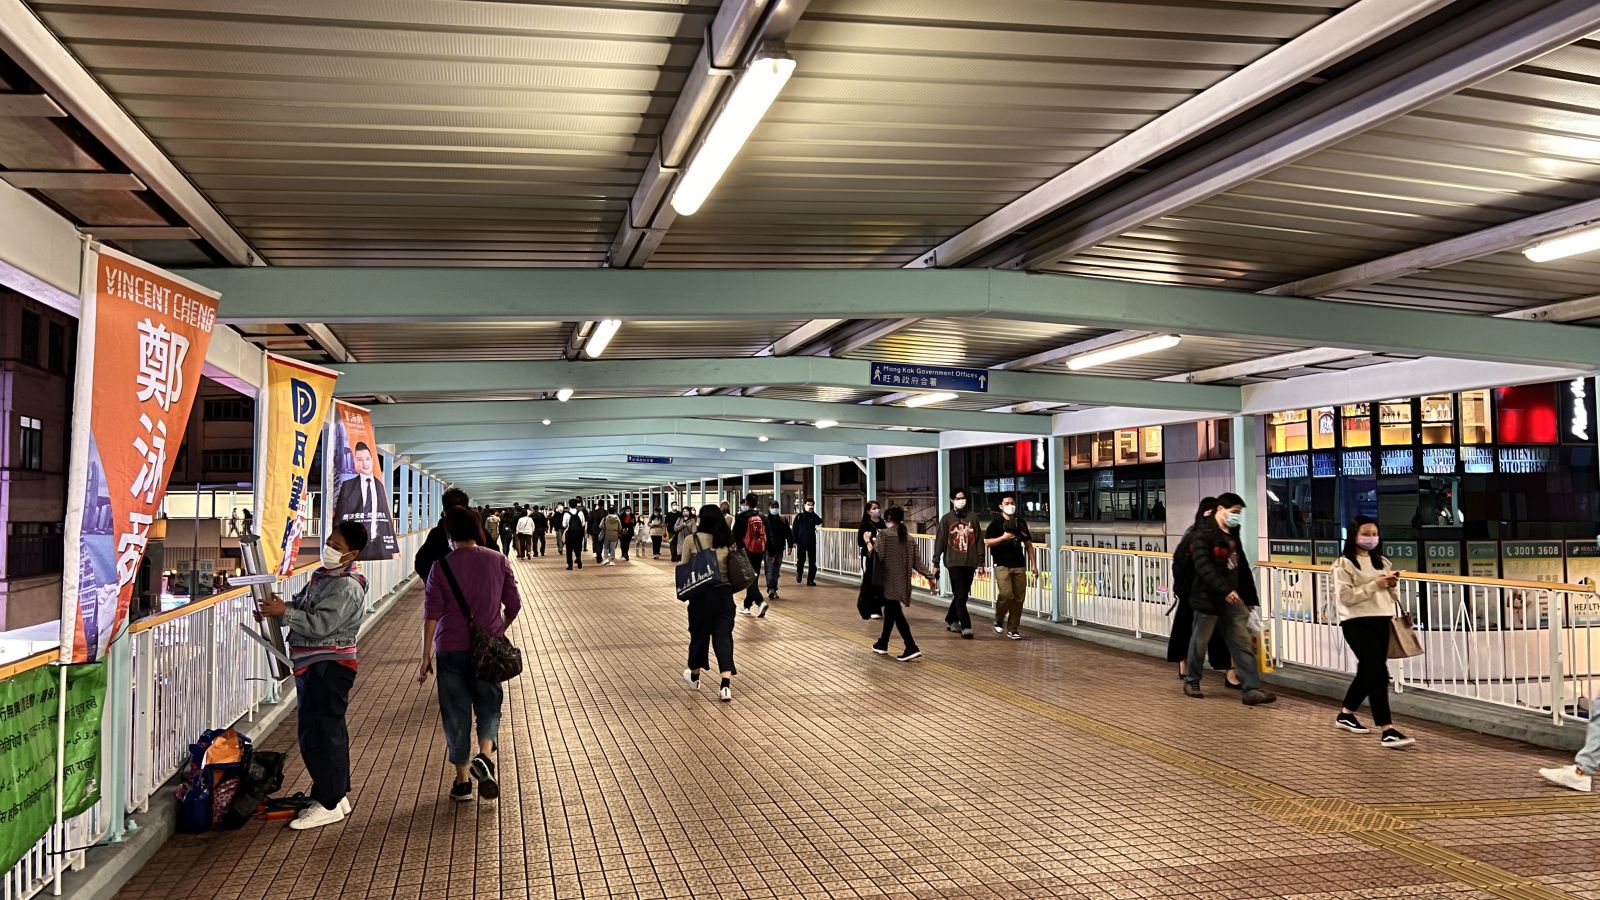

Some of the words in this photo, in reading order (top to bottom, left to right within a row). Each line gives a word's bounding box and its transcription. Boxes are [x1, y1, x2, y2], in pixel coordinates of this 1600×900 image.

[105, 265, 171, 315] VINCENT
[173, 293, 215, 333] CHENG
[883, 365, 901, 373] Mong
[916, 368, 954, 377] Government
[955, 370, 978, 379] Offices
[882, 374, 937, 386] 旺角政府合署
[1386, 546, 1413, 557] 013
[1429, 546, 1455, 557] 608
[1514, 546, 1535, 556] 3001
[1537, 546, 1559, 555] 3608
